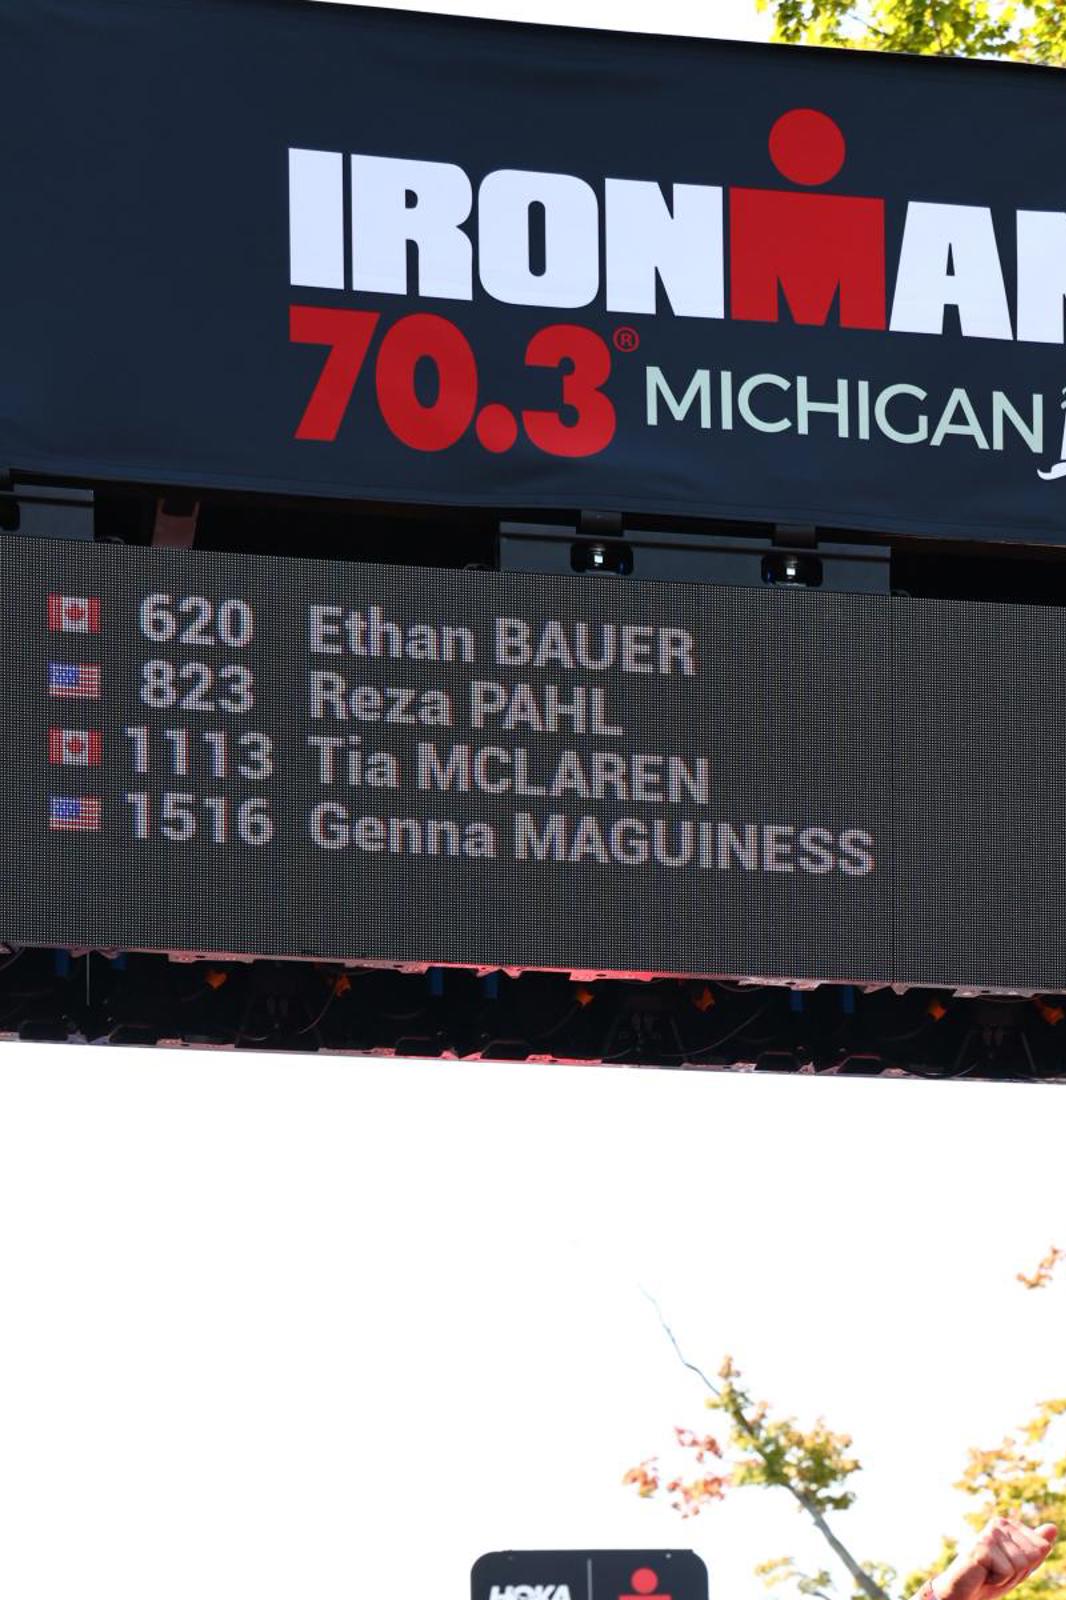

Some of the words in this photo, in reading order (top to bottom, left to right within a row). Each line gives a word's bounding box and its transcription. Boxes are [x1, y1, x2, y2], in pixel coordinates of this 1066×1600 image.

[288, 306, 616, 458] 70.3
[646, 366, 1044, 453] MICHIGAN
[139, 595, 254, 647] 620
[309, 605, 473, 663] Ethan
[496, 617, 697, 677] BAUER
[140, 660, 254, 713] 823
[310, 673, 451, 726] Reza
[471, 680, 624, 737] PAHL
[124, 726, 274, 781] 1113
[308, 736, 398, 789] Tia
[418, 745, 709, 804] MCLAREN
[127, 791, 274, 845] 1516
[310, 804, 496, 858] Genna
[515, 812, 875, 876] MAGUINESS
